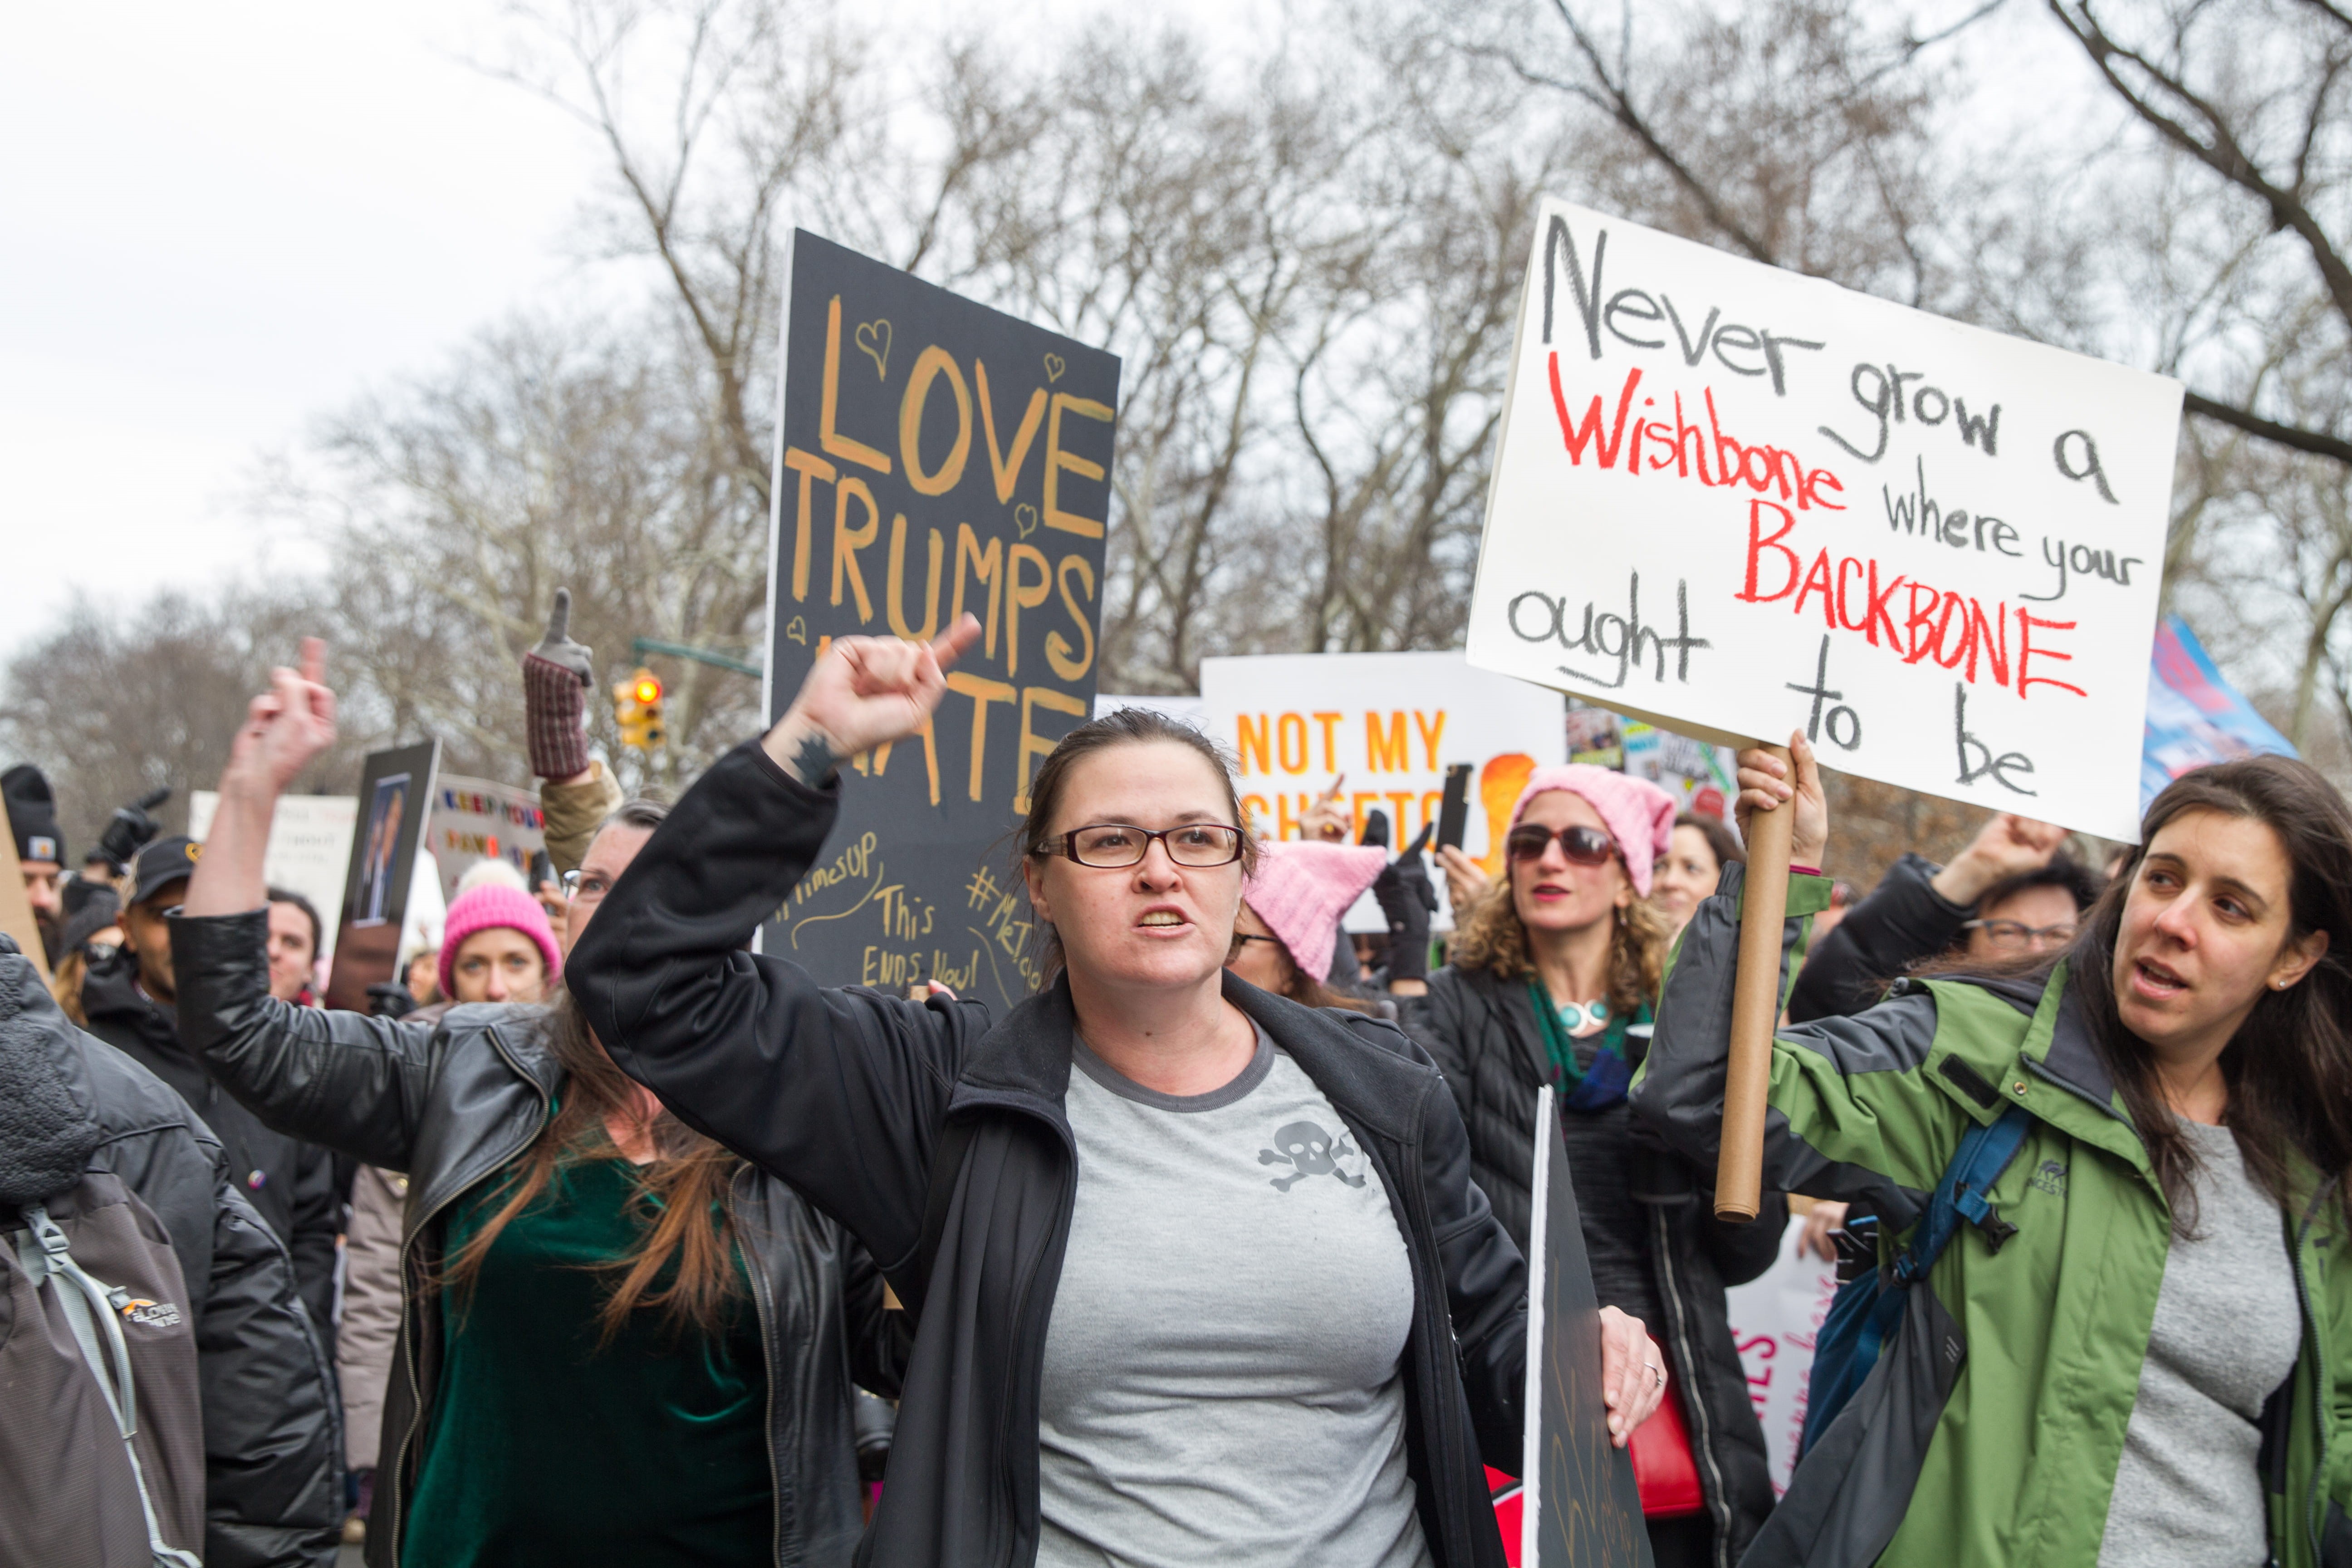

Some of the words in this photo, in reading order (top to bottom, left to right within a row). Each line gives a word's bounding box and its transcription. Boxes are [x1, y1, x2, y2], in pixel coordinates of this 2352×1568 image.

[819, 294, 1115, 539] LOVE
[1543, 214, 1826, 397] Never
[1818, 363, 2001, 464] grow
[2053, 430, 2120, 505] a
[784, 446, 1094, 681] TRUMPS
[1548, 351, 1847, 511] Wishbone
[1883, 454, 2023, 557] where
[2019, 536, 2144, 601] your
[1508, 565, 1714, 689] ought
[1785, 633, 1861, 751] to
[1955, 681, 2038, 797] be
[1734, 498, 2087, 700] BACKBONE
[815, 635, 1086, 816] TE
[1237, 711, 1344, 776] NOT
[1365, 710, 1447, 774] MY
[1238, 791, 1444, 854] CHETO
[874, 884, 935, 941] This
